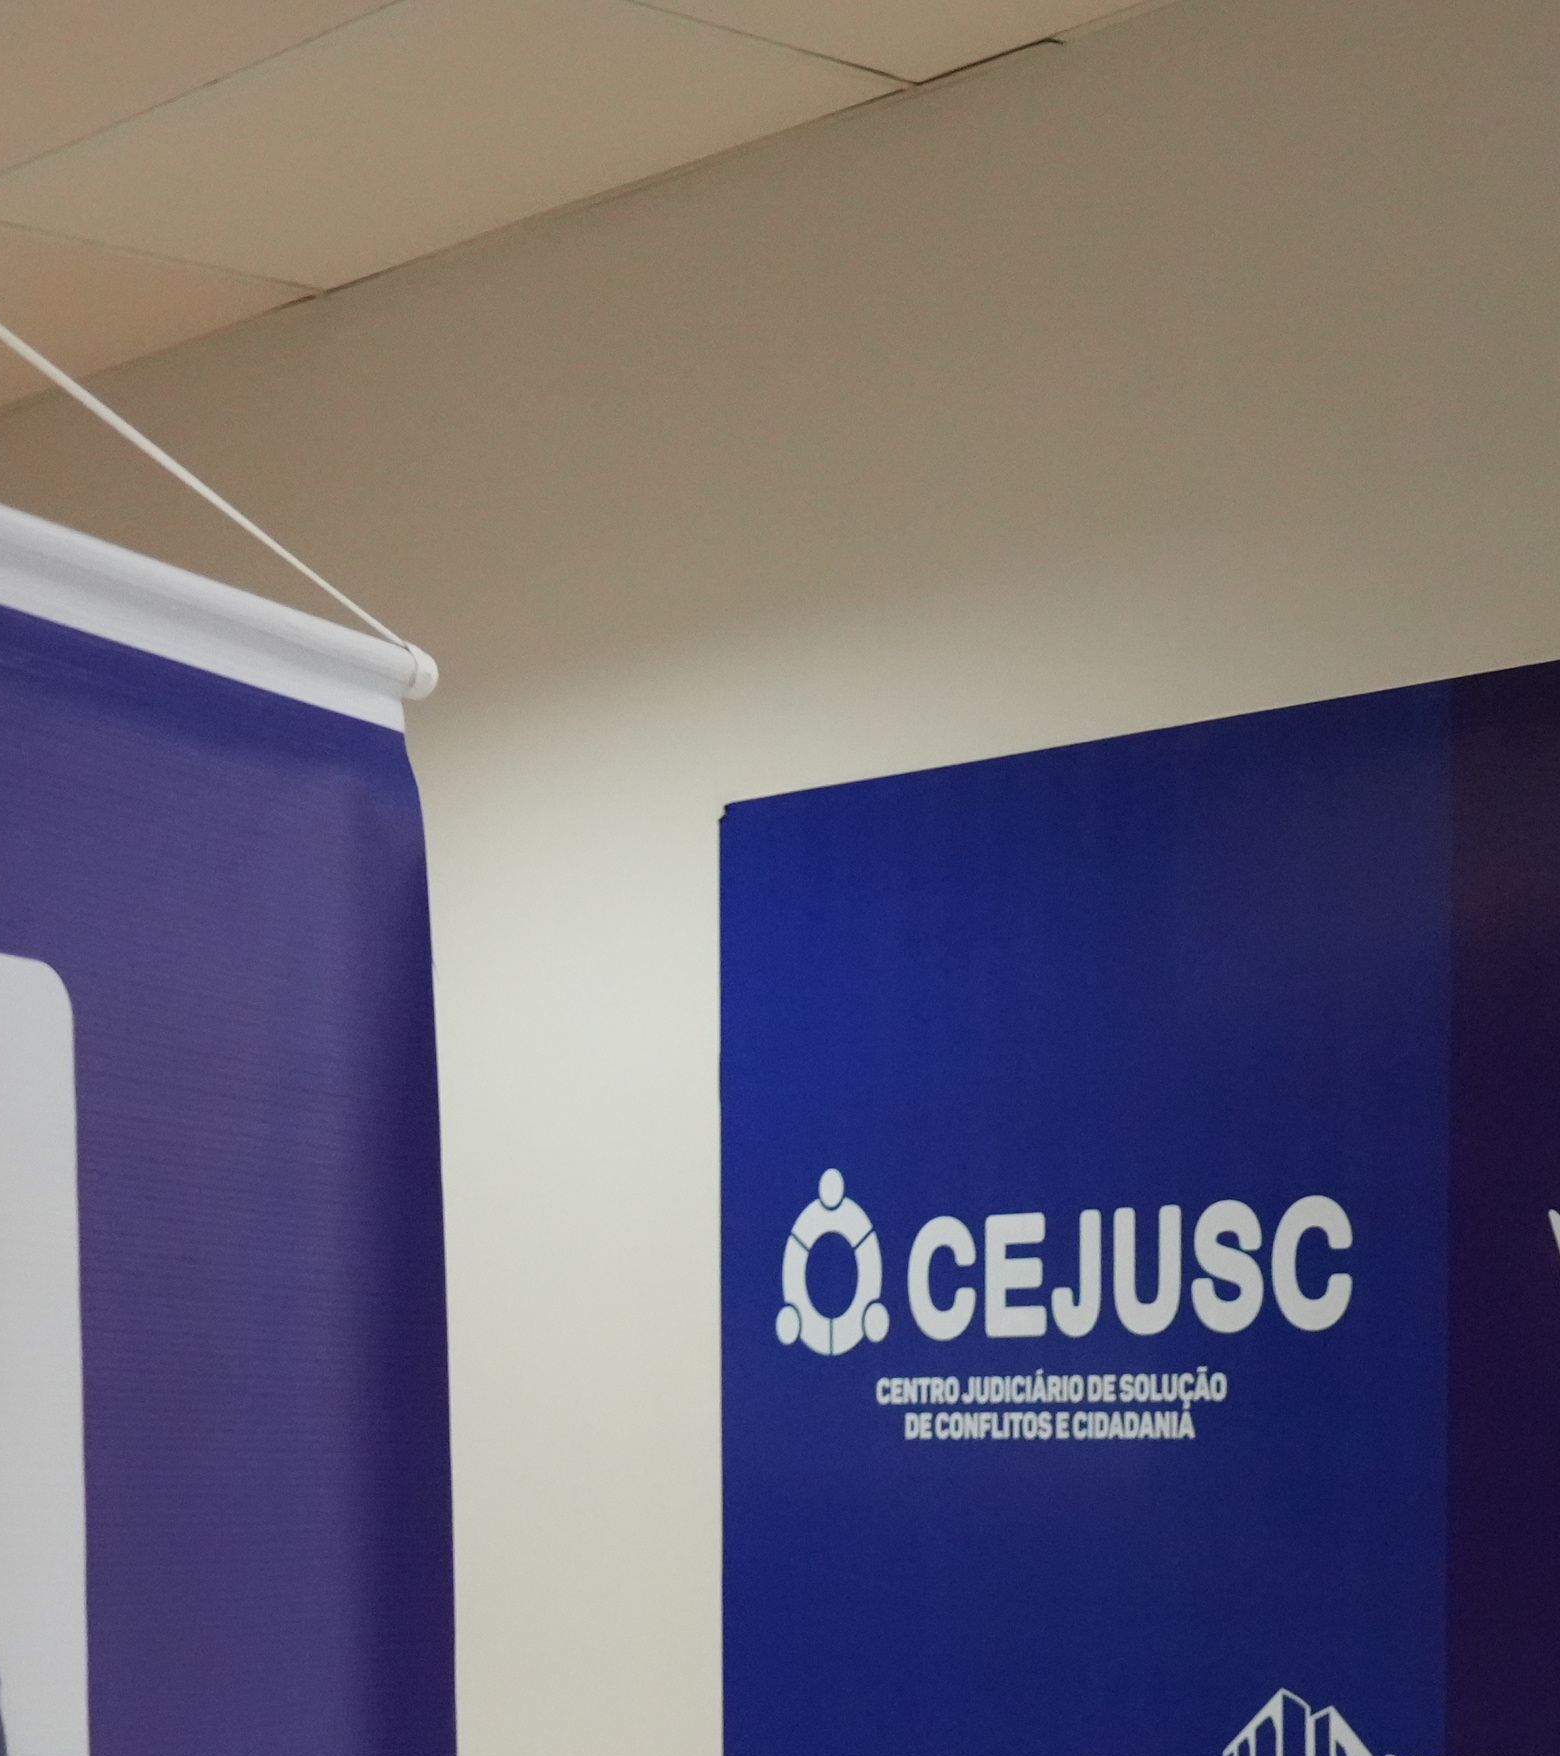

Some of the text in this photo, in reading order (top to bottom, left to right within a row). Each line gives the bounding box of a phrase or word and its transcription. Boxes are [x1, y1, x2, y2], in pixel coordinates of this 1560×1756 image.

[907, 1195, 1353, 1342] CEJUSC
[876, 1366, 1227, 1409] CENTRO JUDICIÁRIO DE SOLUÇÃO
[904, 1411, 1196, 1440] DE CONFLITOS E CIDADANIA
